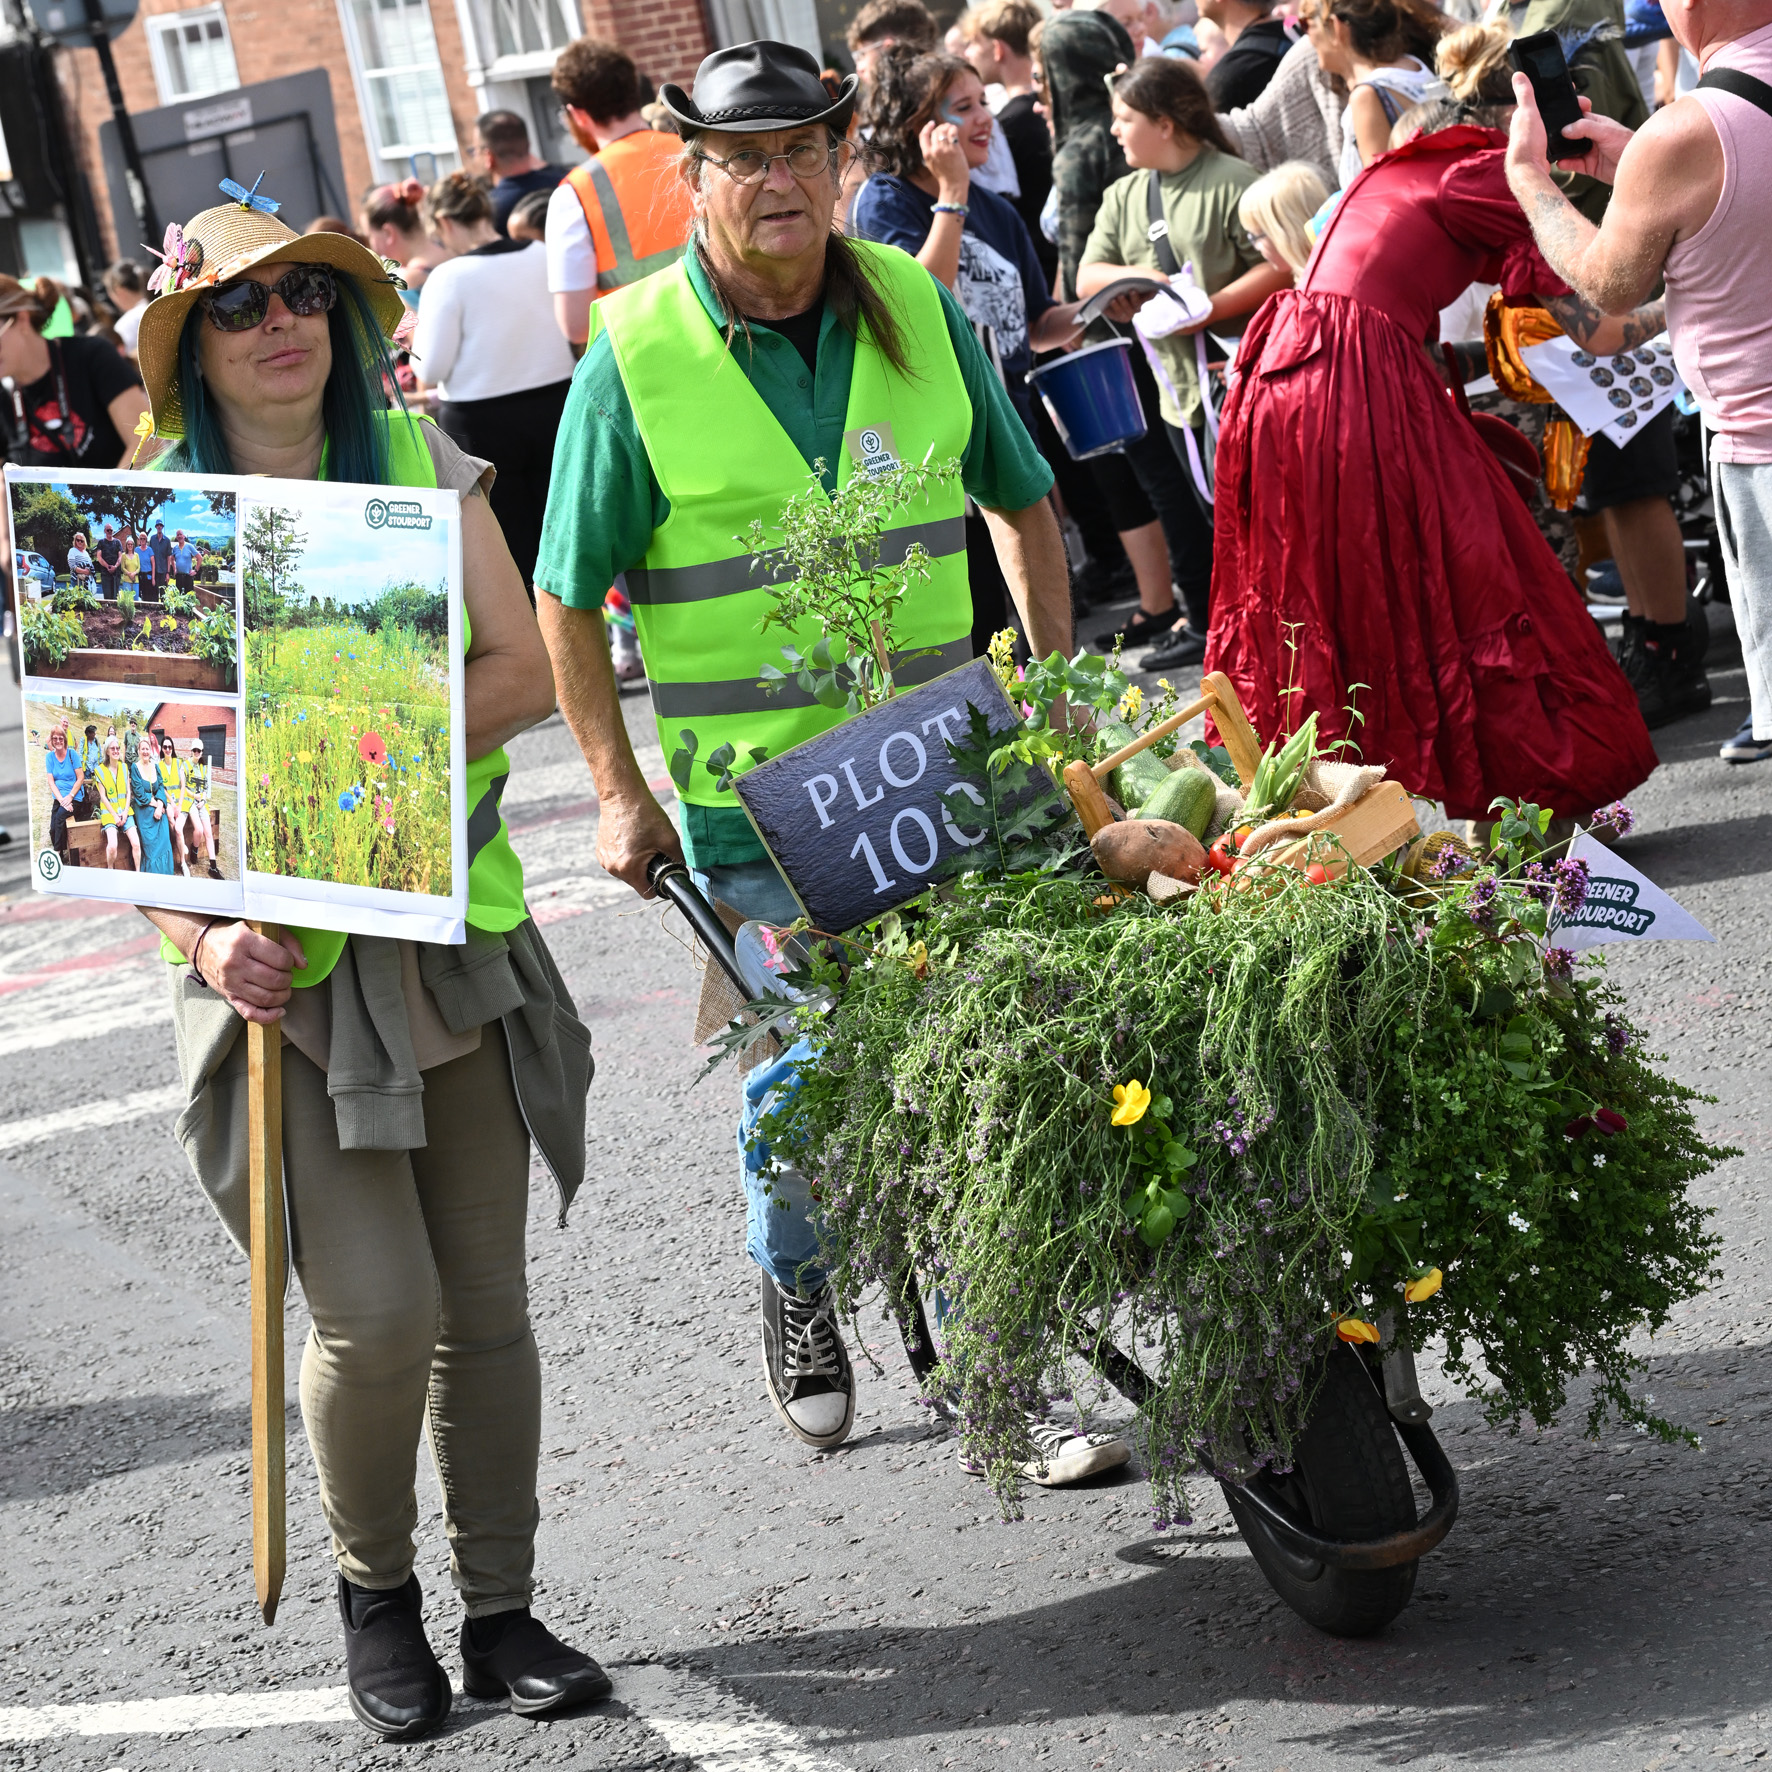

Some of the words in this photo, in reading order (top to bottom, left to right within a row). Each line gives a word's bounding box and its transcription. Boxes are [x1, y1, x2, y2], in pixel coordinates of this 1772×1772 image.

[863, 453, 891, 467] GREENER
[866, 461, 900, 476] TOURPORT
[388, 503, 421, 514] GREENER
[387, 515, 431, 528] STOURPORT
[801, 706, 962, 830] PLOT
[849, 781, 989, 895] 100
[1585, 882, 1634, 903] EENER
